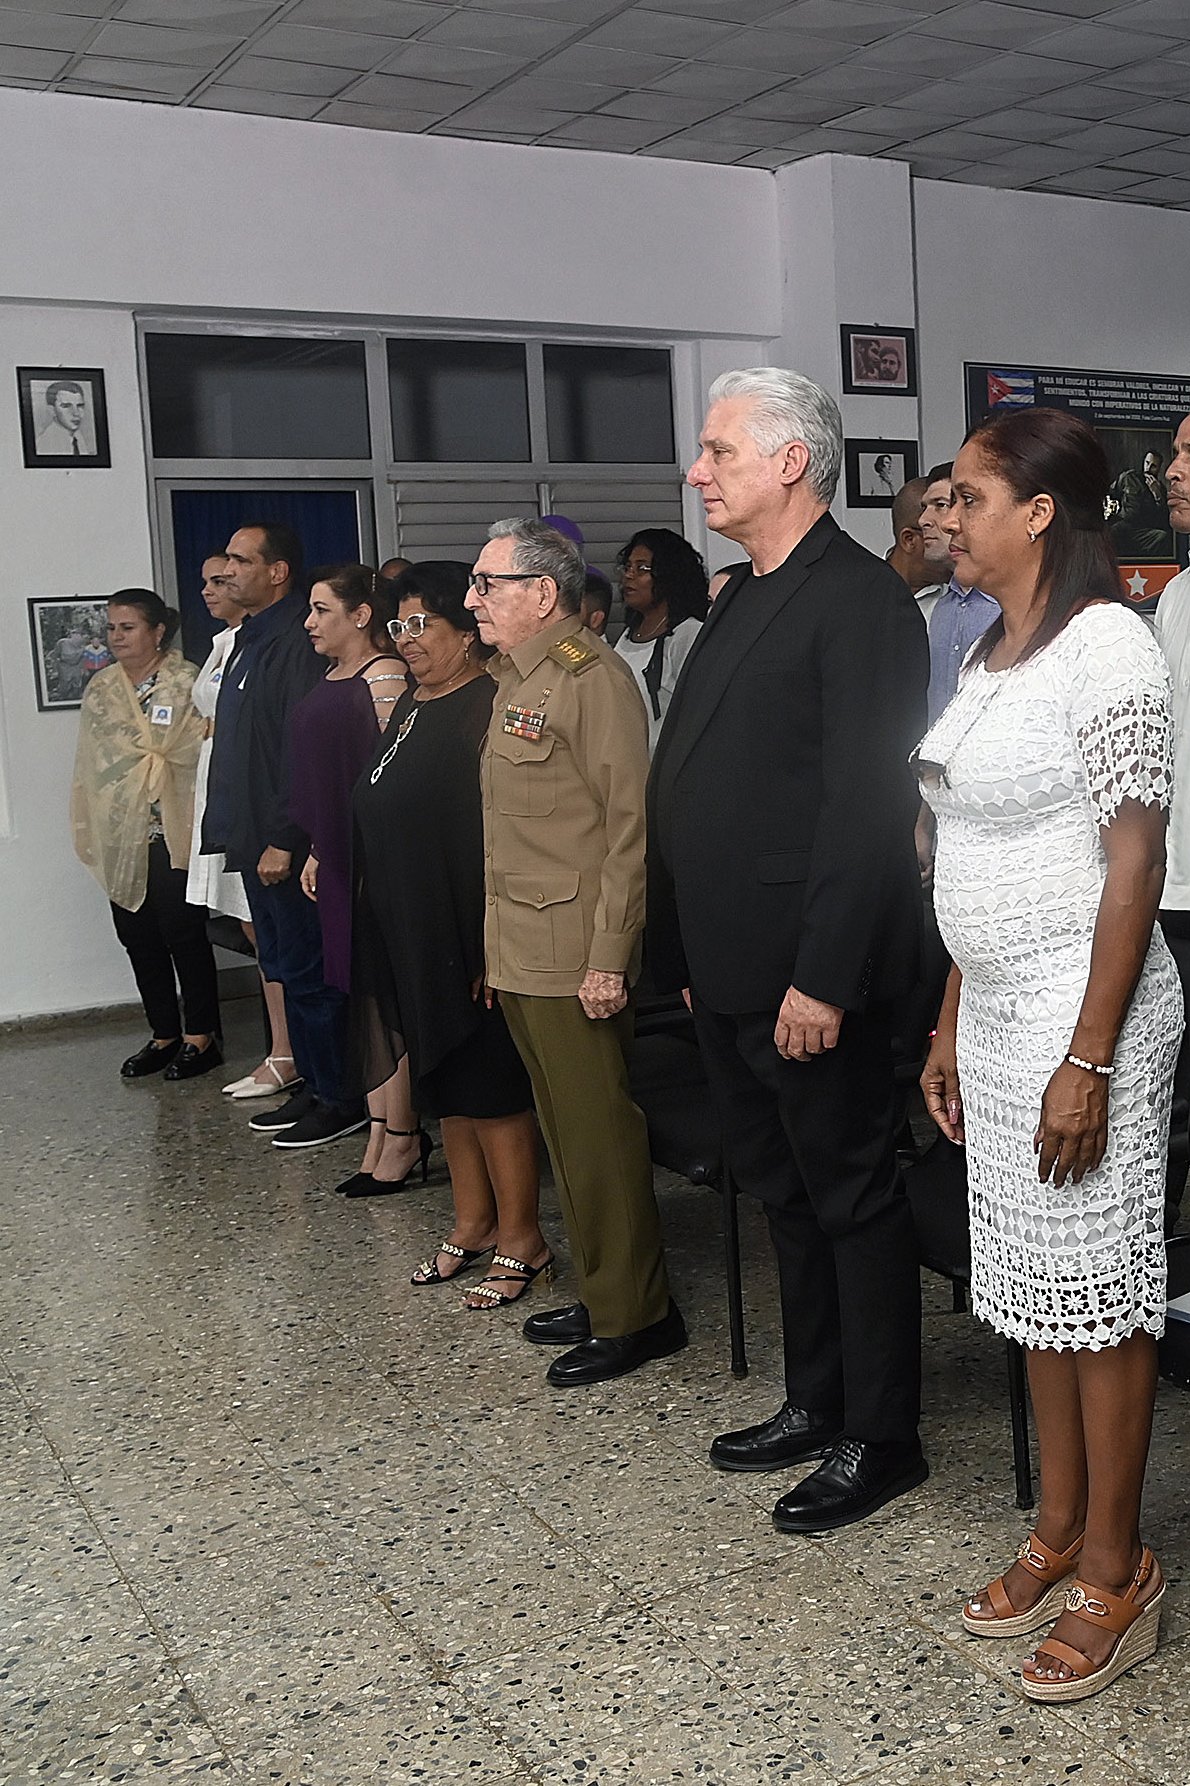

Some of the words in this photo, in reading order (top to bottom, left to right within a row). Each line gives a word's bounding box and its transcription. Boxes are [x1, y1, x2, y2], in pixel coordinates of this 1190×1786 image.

[1038, 376, 1054, 384] PARA
[1064, 378, 1088, 386] EDUCAR
[1089, 379, 1096, 387] ES
[1097, 380, 1124, 388] SEMBRAR
[1152, 383, 1179, 392] INCULCAR
[1089, 390, 1131, 399] TRANSFORMAR
[1148, 393, 1179, 402] CRIATURAS
[1105, 401, 1142, 410] IMPERATIVOS
